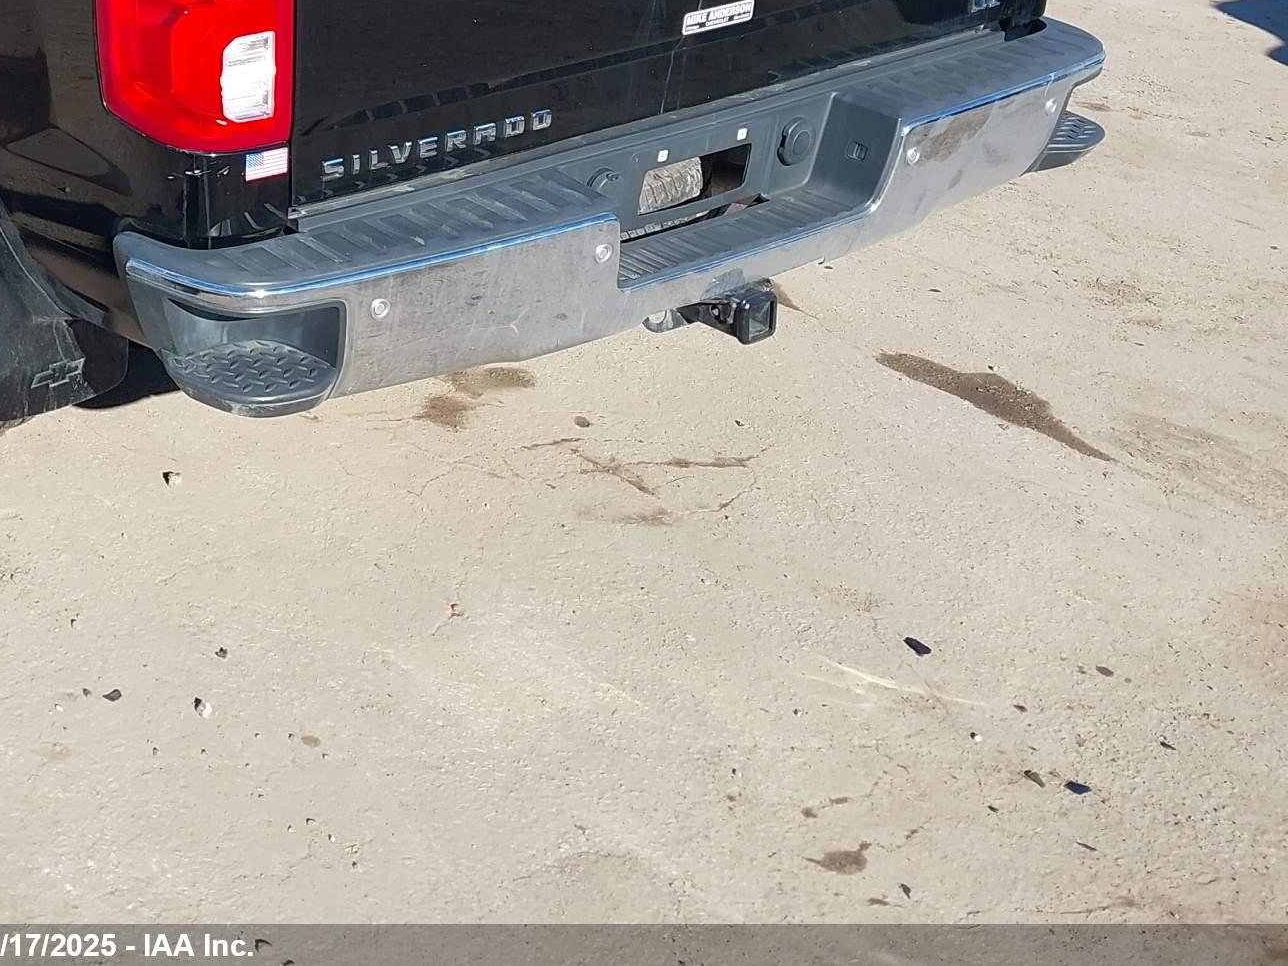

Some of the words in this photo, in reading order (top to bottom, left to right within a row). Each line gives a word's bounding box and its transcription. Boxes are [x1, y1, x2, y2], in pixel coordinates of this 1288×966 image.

[686, 13, 707, 26] MIKE
[708, 2, 752, 21] ANDERSON
[320, 108, 552, 180] SILVERADO
